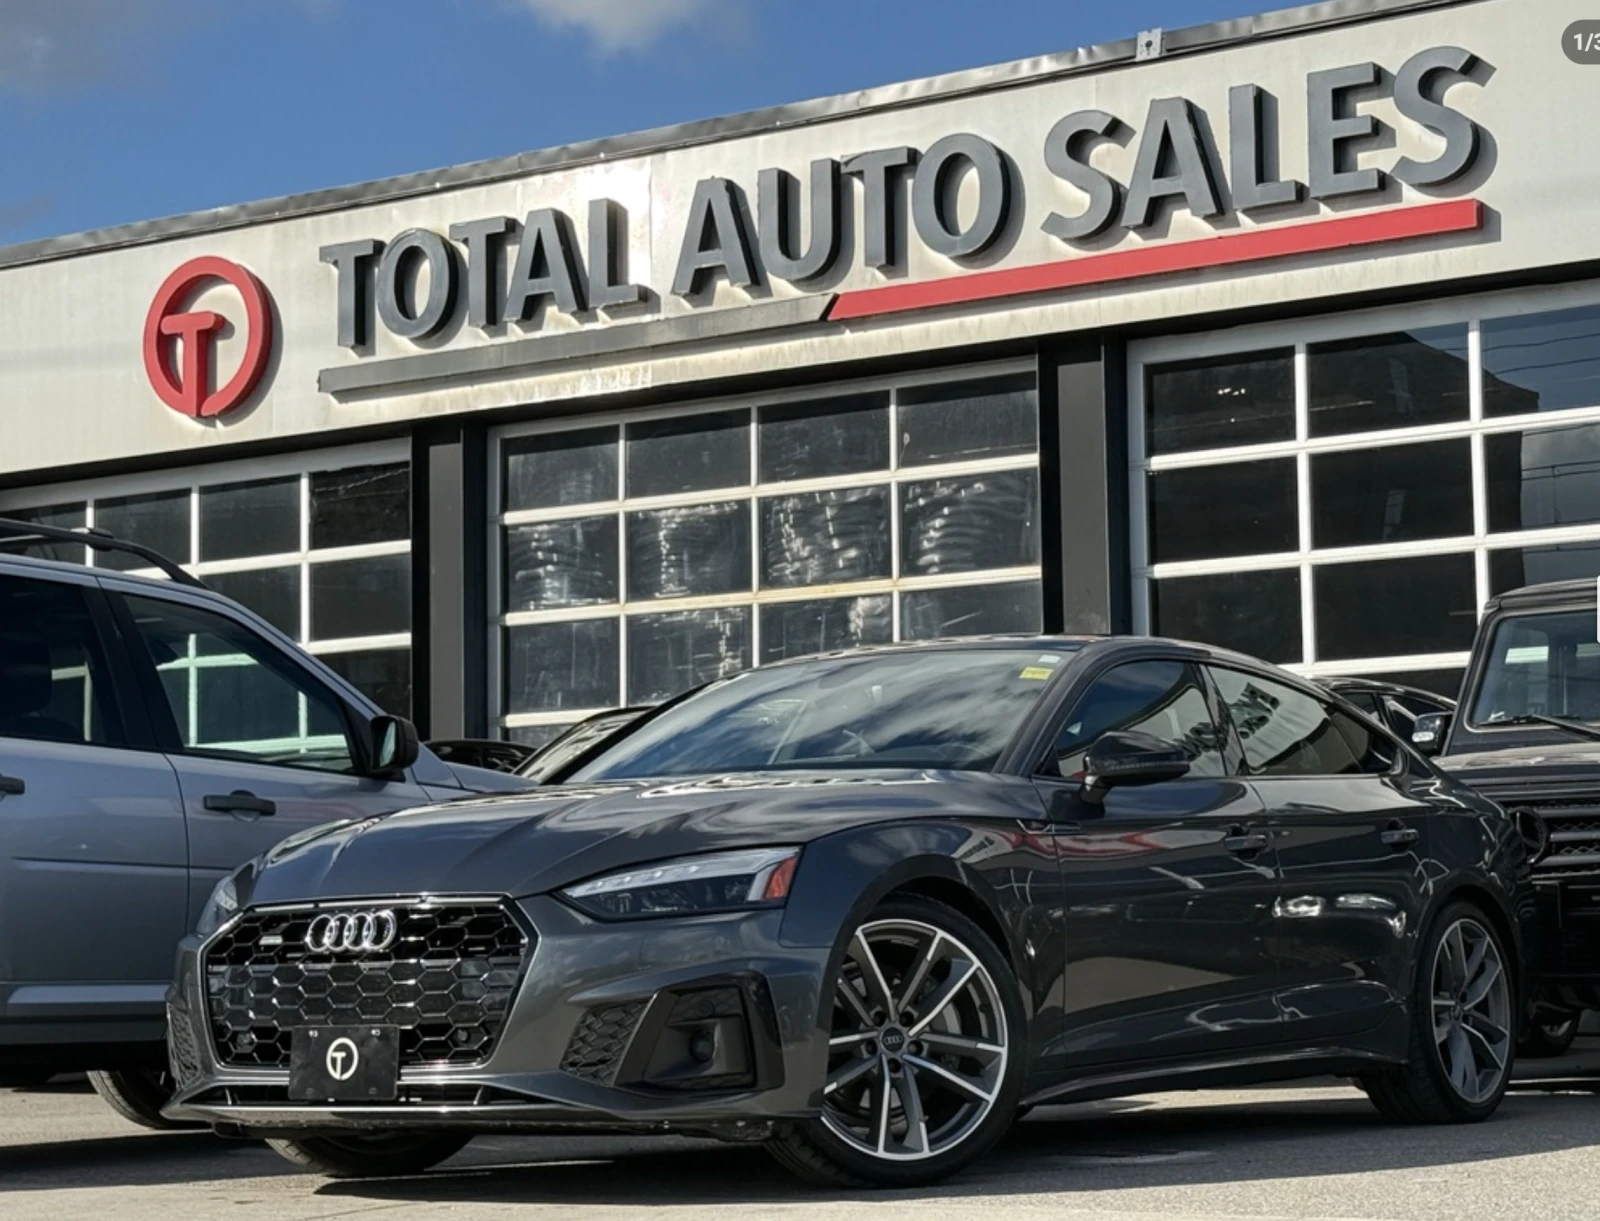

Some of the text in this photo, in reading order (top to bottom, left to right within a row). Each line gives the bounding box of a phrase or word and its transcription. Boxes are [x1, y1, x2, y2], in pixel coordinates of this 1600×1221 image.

[319, 45, 1486, 348] TOTAL AUTO SALES
